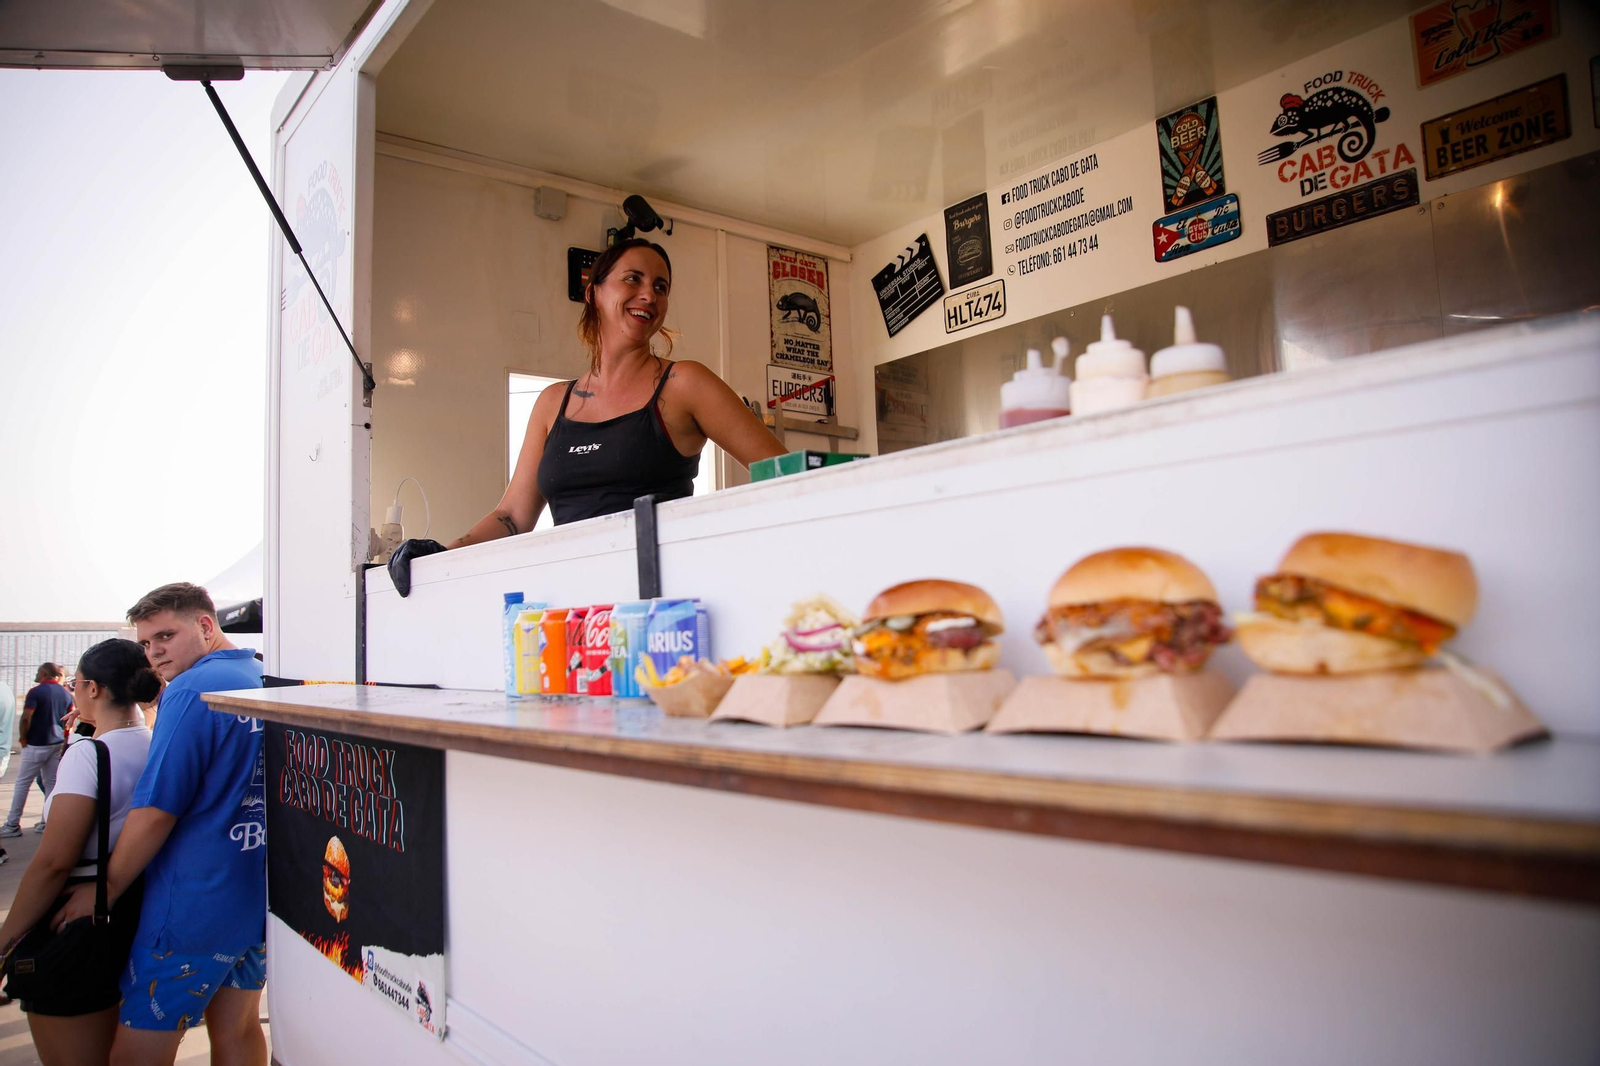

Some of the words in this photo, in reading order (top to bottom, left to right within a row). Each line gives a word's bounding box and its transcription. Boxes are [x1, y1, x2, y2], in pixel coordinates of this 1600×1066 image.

[1434, 30, 1481, 70] Cold
[1303, 71, 1343, 94] FOOD
[1348, 71, 1386, 104] TRUCK
[1176, 119, 1199, 134] COLD
[1456, 106, 1522, 135] Welcome
[1171, 126, 1207, 149] BEER
[1436, 134, 1490, 169] BEER
[1497, 111, 1557, 150] ZONE
[1012, 183, 1029, 203] FOOD
[1029, 173, 1051, 196] TRUCK
[1051, 165, 1070, 187] CABO
[1070, 161, 1080, 179] DE
[1080, 153, 1099, 175] GATA
[1300, 172, 1328, 197] DE
[1330, 143, 1417, 189] GATA
[953, 213, 982, 230] Burgers
[1014, 187, 1085, 230] @FOODTRUCKCABODE
[1276, 179, 1409, 238] BURGERS
[1015, 196, 1133, 253] FOODTRUCKCABODEGATA@GMAIL.COM
[1211, 219, 1238, 235] Cuba
[780, 254, 797, 264] KEEP
[799, 258, 817, 269] GATE
[1018, 251, 1053, 276] TELÉFONO:
[1052, 245, 1066, 264] 661
[1067, 241, 1078, 259] 44
[1078, 237, 1088, 255] 73
[1089, 234, 1099, 251] 44
[772, 260, 825, 291] CLOSED
[880, 275, 902, 297] UNIVERSAL
[947, 290, 1002, 329] HLT474
[966, 291, 980, 300] CUBA
[775, 353, 815, 364] CHAMELEON
[816, 359, 829, 367] SAY
[783, 338, 793, 346] NO
[794, 341, 820, 351] MATTER
[785, 346, 805, 355] WHAT
[806, 349, 819, 358] THE
[772, 380, 828, 405] EUROCR3
[285, 730, 329, 778] FOOD
[332, 739, 396, 799] TRUCK
[280, 766, 320, 817] CABO
[322, 779, 347, 828] DE
[350, 788, 404, 853] GATA
